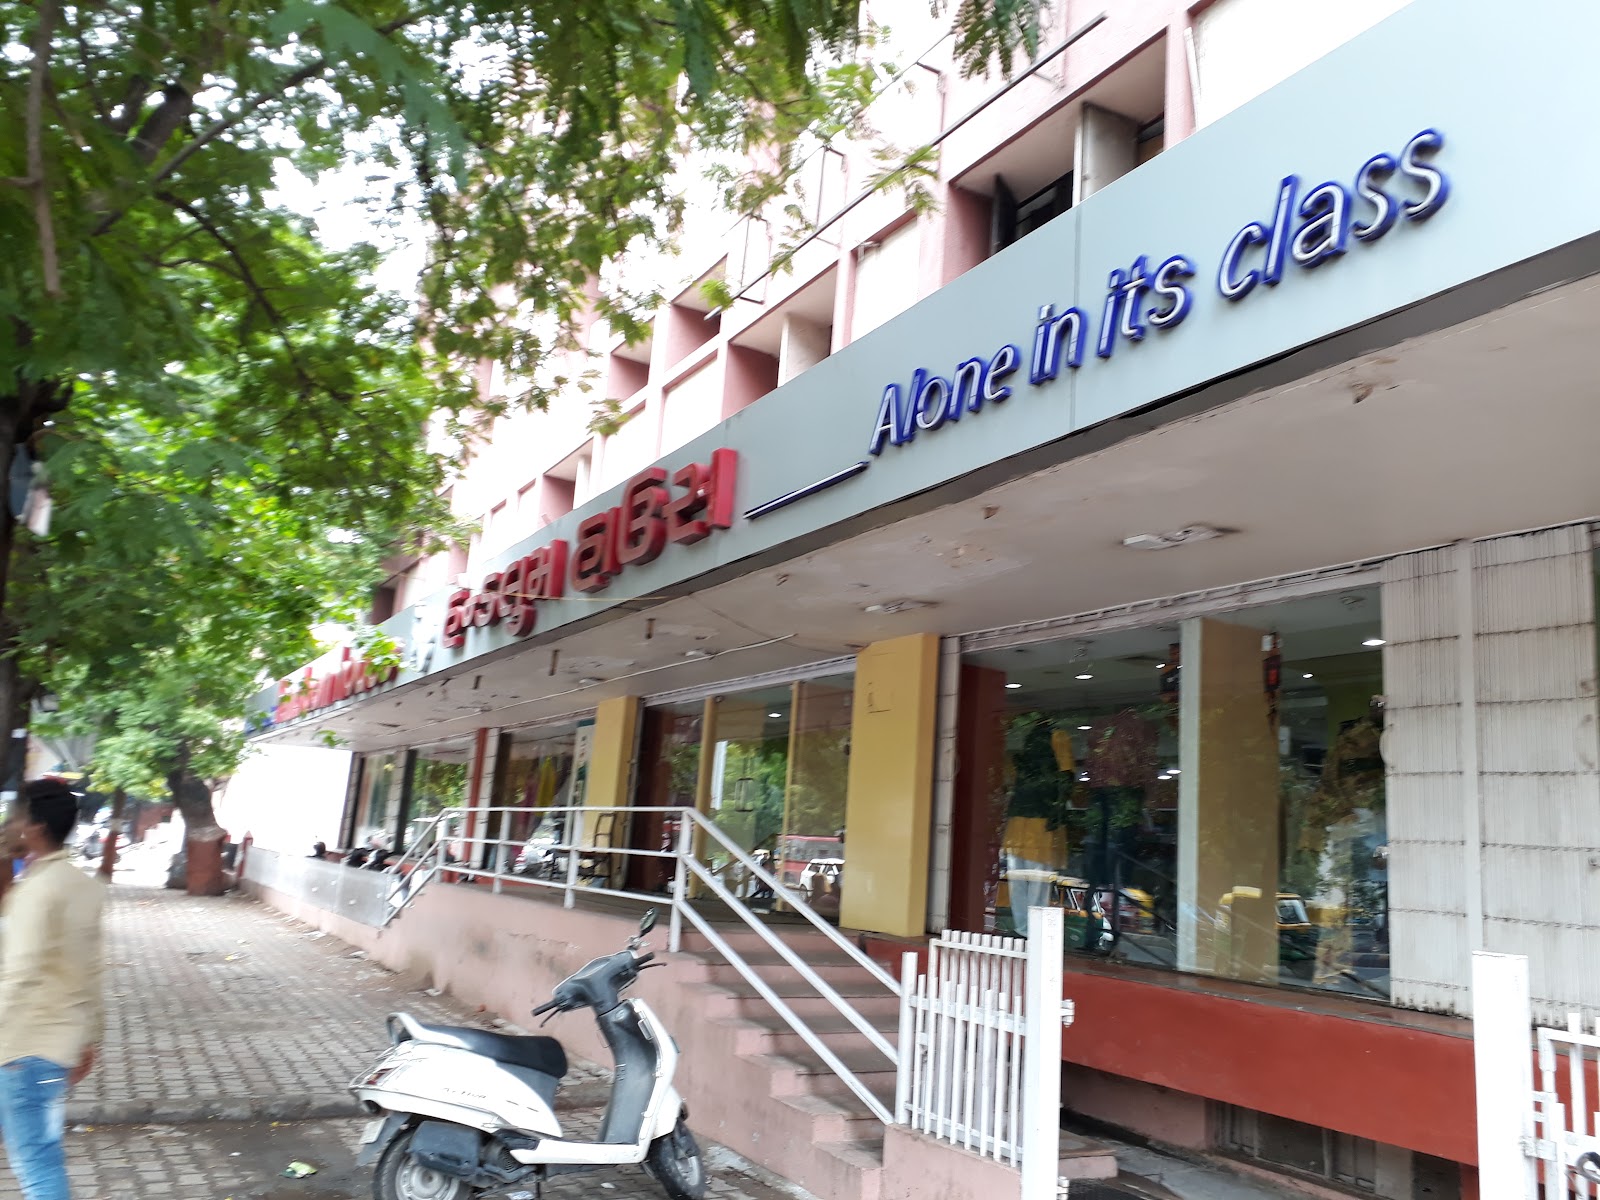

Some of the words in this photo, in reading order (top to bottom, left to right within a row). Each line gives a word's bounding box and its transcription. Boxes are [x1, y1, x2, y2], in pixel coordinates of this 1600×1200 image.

[869, 344, 1020, 456] Alone
[1029, 303, 1088, 386] in
[1098, 254, 1196, 358] its
[1218, 127, 1450, 302] class
[571, 448, 738, 594] હાઉસ
